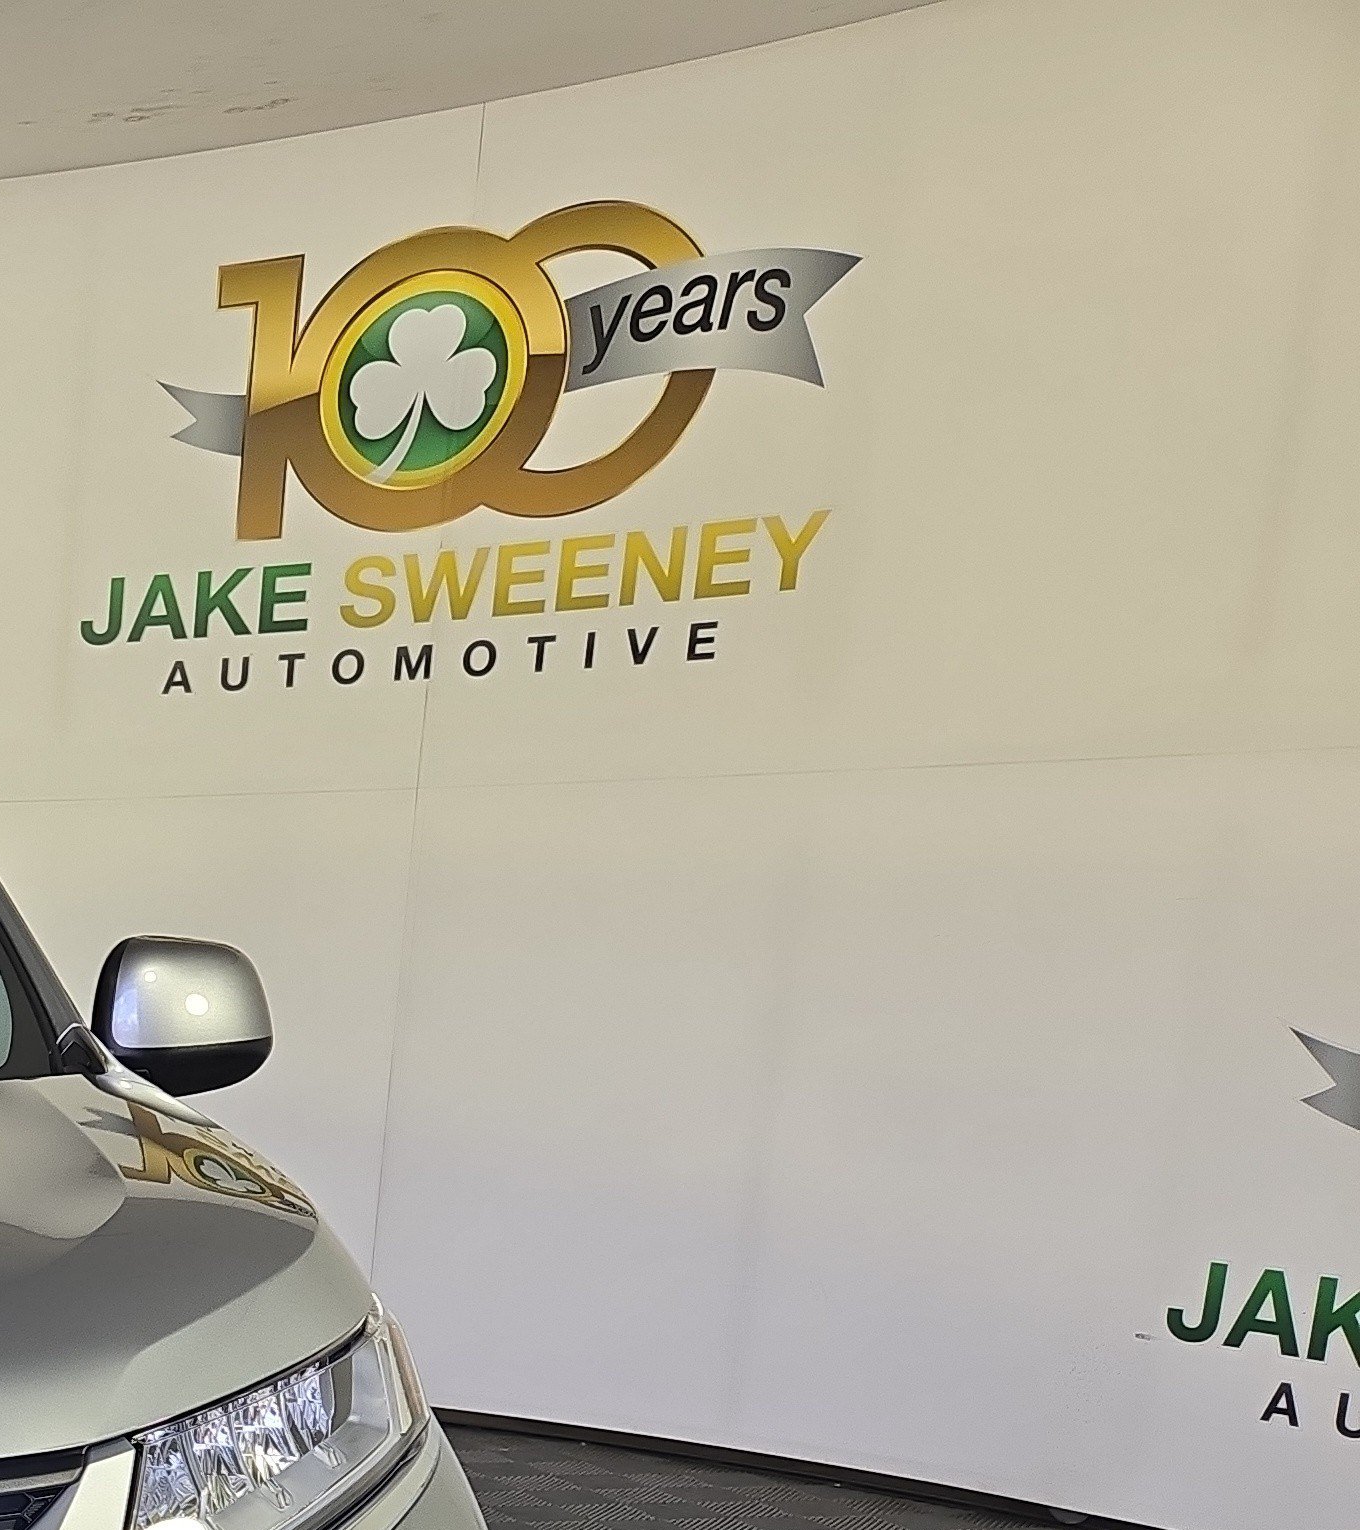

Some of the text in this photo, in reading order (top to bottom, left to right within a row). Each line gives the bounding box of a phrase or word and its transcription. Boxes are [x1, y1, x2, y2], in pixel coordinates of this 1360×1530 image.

[217, 200, 793, 541] 100 years
[79, 508, 833, 646] JAKE SWEENEY
[161, 620, 720, 696] AUTOMOTIVE
[1166, 1261, 1360, 1368] JAK
